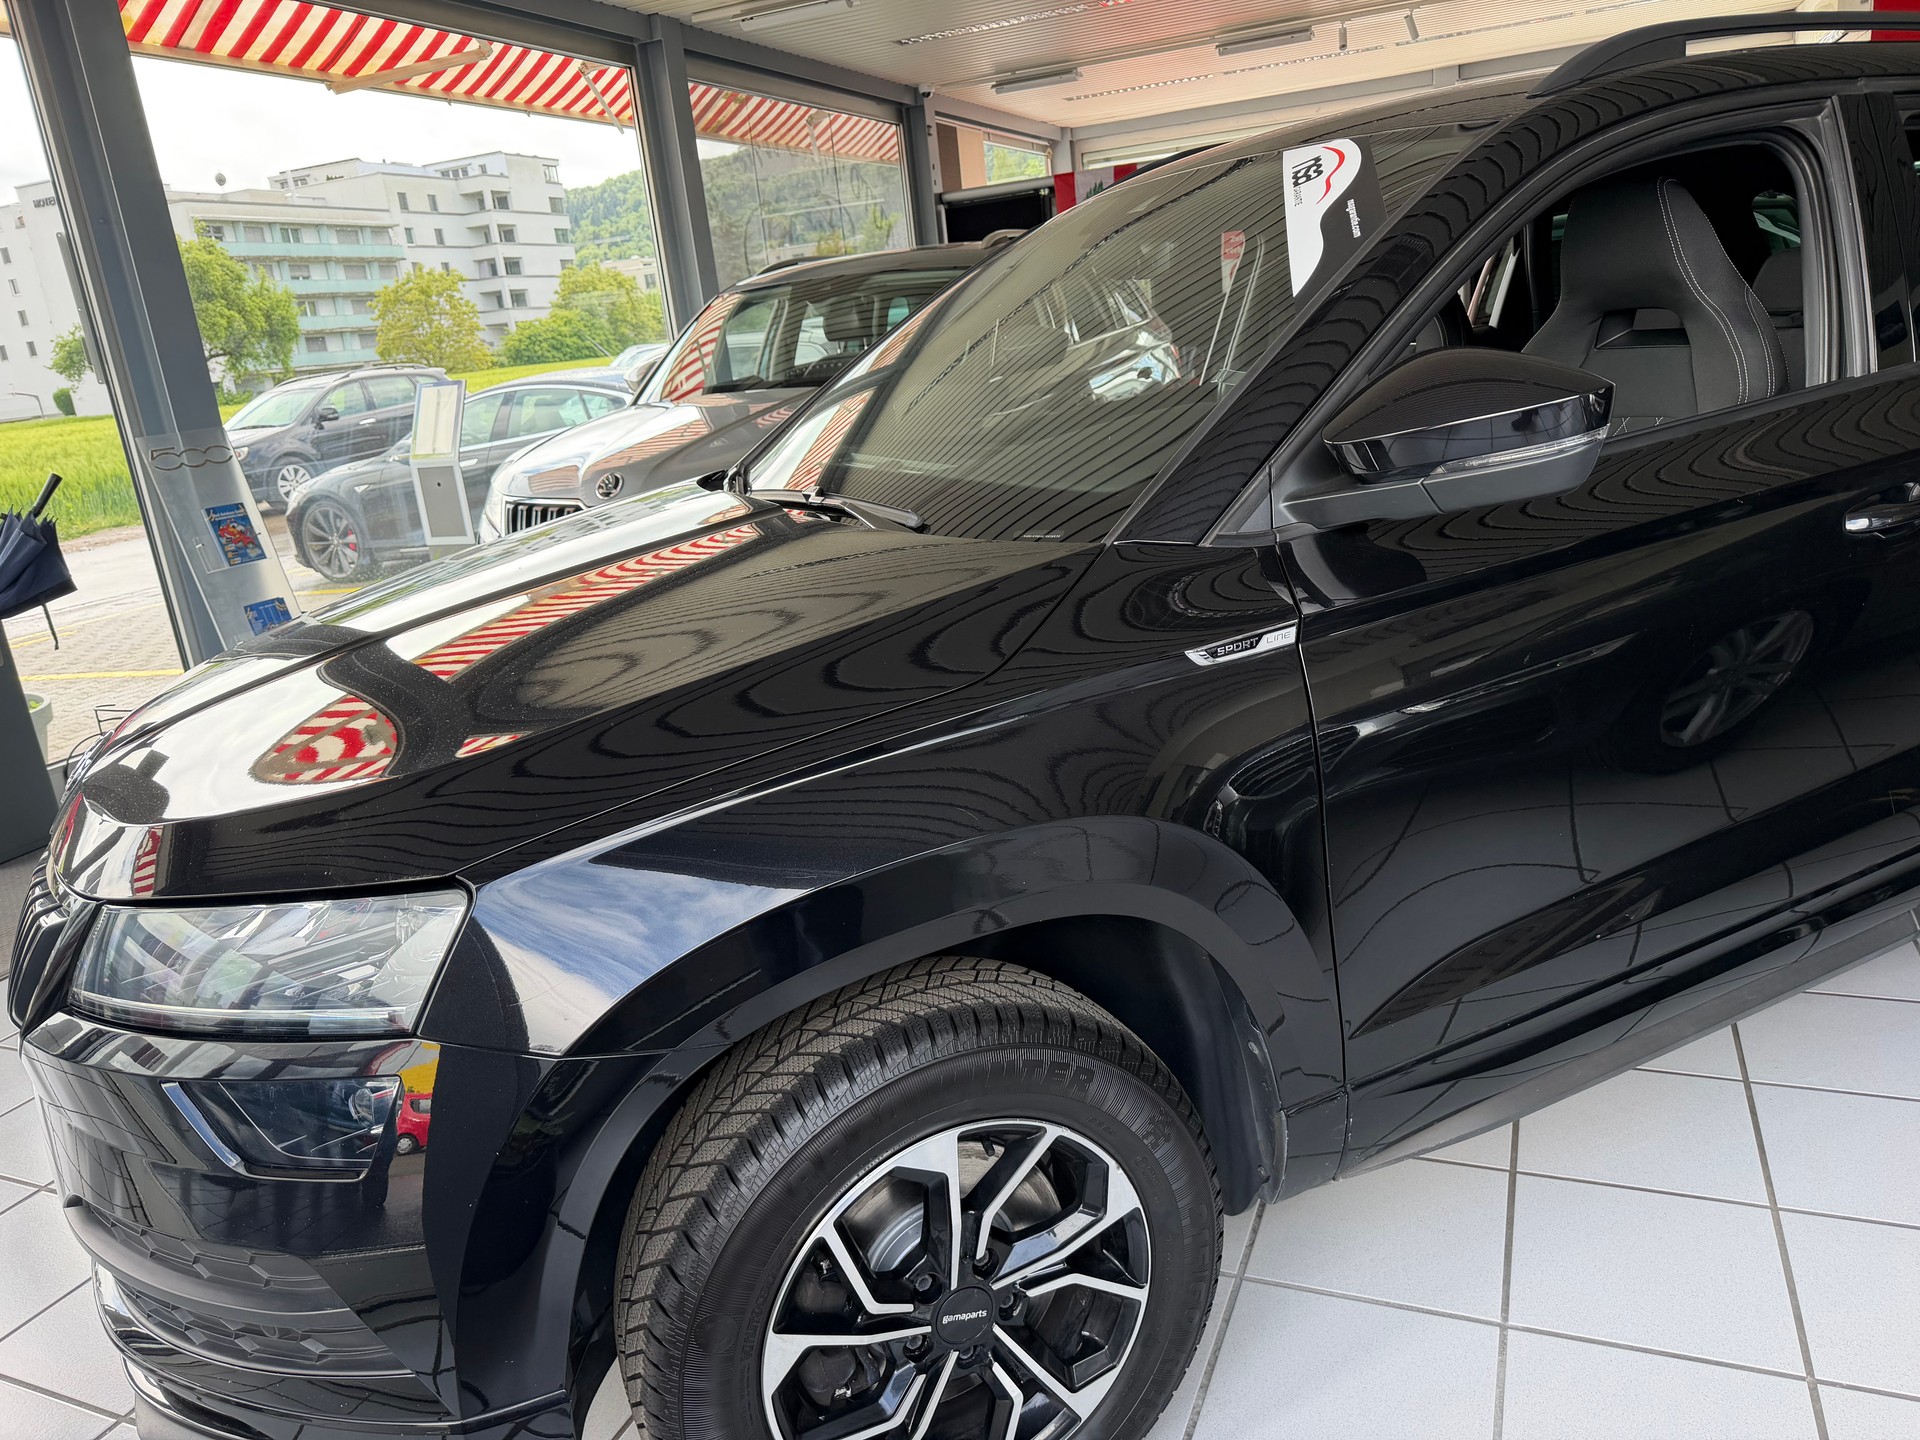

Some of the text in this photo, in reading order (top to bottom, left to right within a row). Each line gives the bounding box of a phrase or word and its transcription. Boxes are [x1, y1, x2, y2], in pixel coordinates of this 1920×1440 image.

[149, 444, 233, 471] 500
[1216, 631, 1291, 656] SPORT LINE
[941, 1309, 988, 1325] gamaparts
